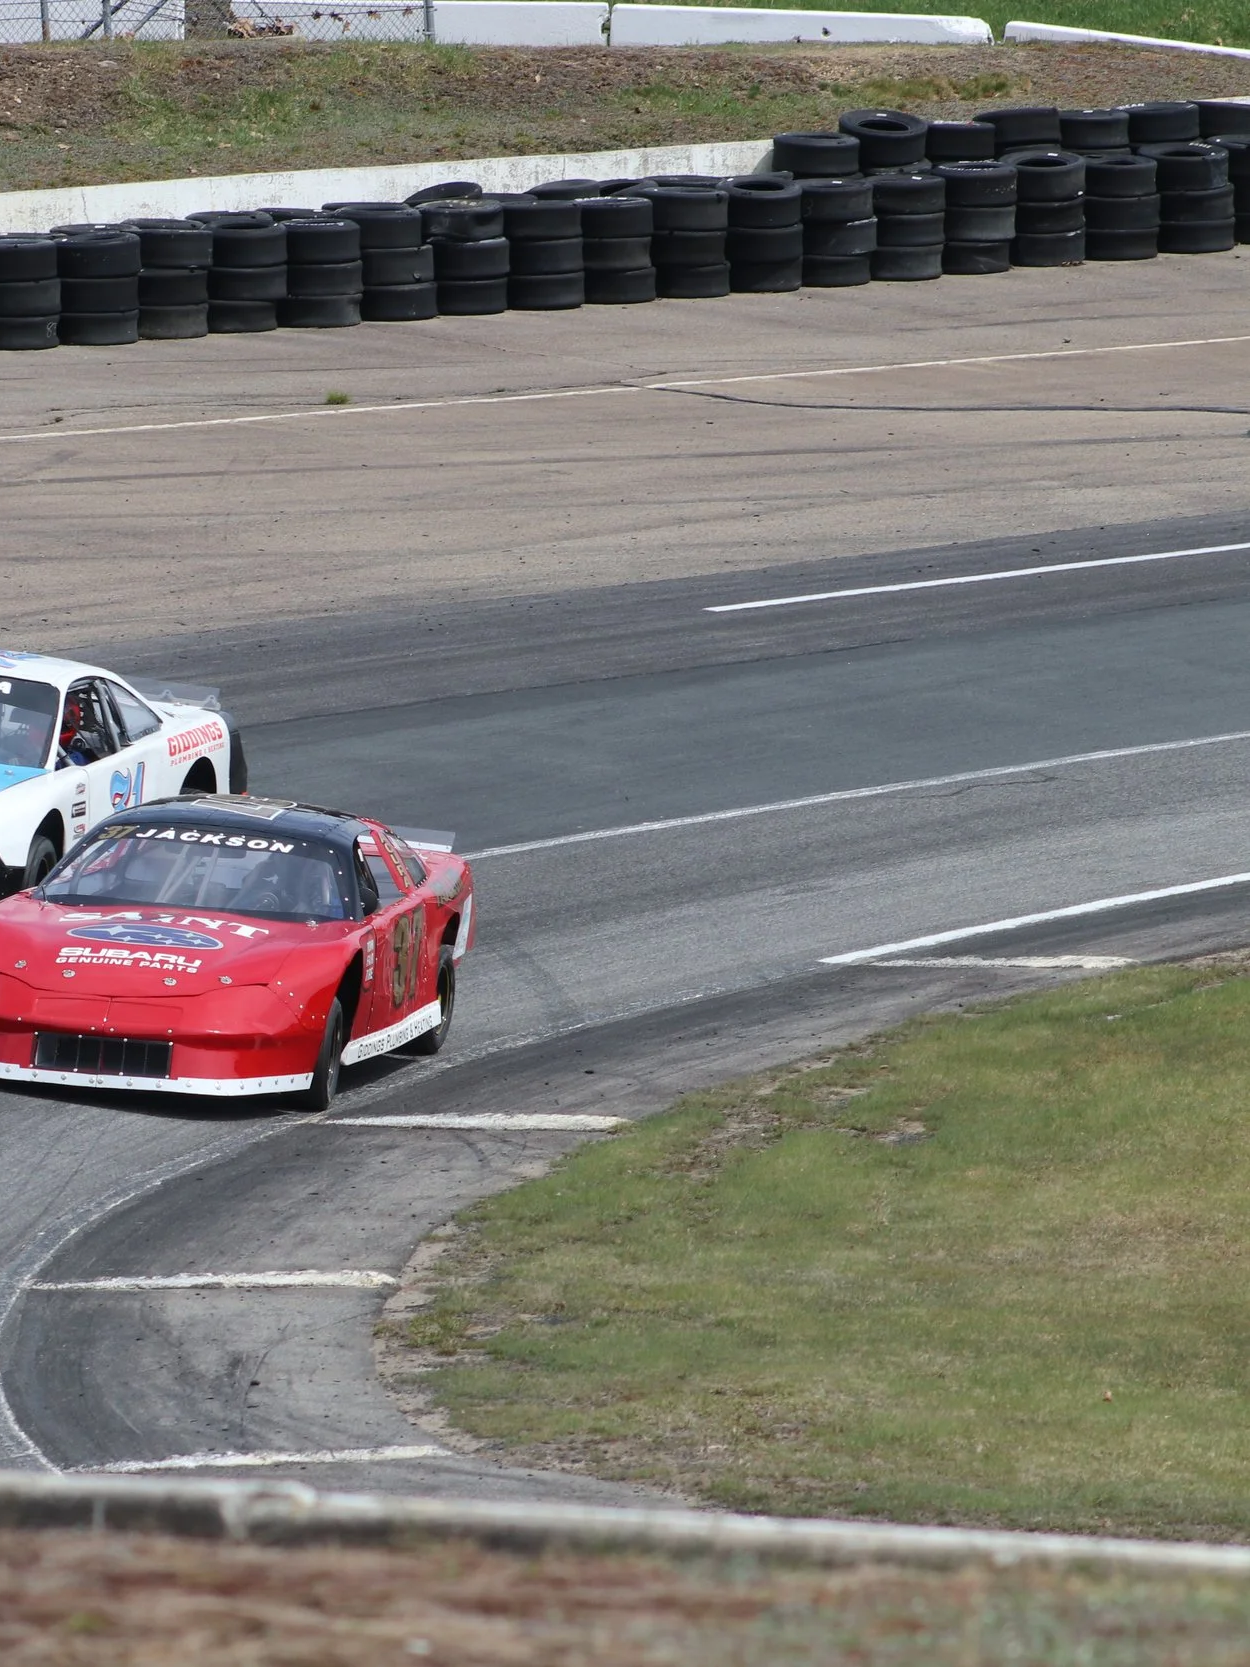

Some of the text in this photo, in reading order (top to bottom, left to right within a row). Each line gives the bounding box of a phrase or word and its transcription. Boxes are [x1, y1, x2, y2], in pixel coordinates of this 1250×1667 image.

[167, 721, 223, 757] GIDDINGS
[170, 749, 203, 766] PLUMBING
[98, 825, 138, 839] 37
[135, 828, 295, 854] JACKSON
[55, 957, 199, 974] GENUINE PARTS
[58, 946, 202, 968] SUBARU
[392, 905, 424, 1008] 37
[357, 1038, 385, 1058] GIDDINGS
[386, 1028, 409, 1048] PLUMBING
[414, 1015, 433, 1035] HEATING
